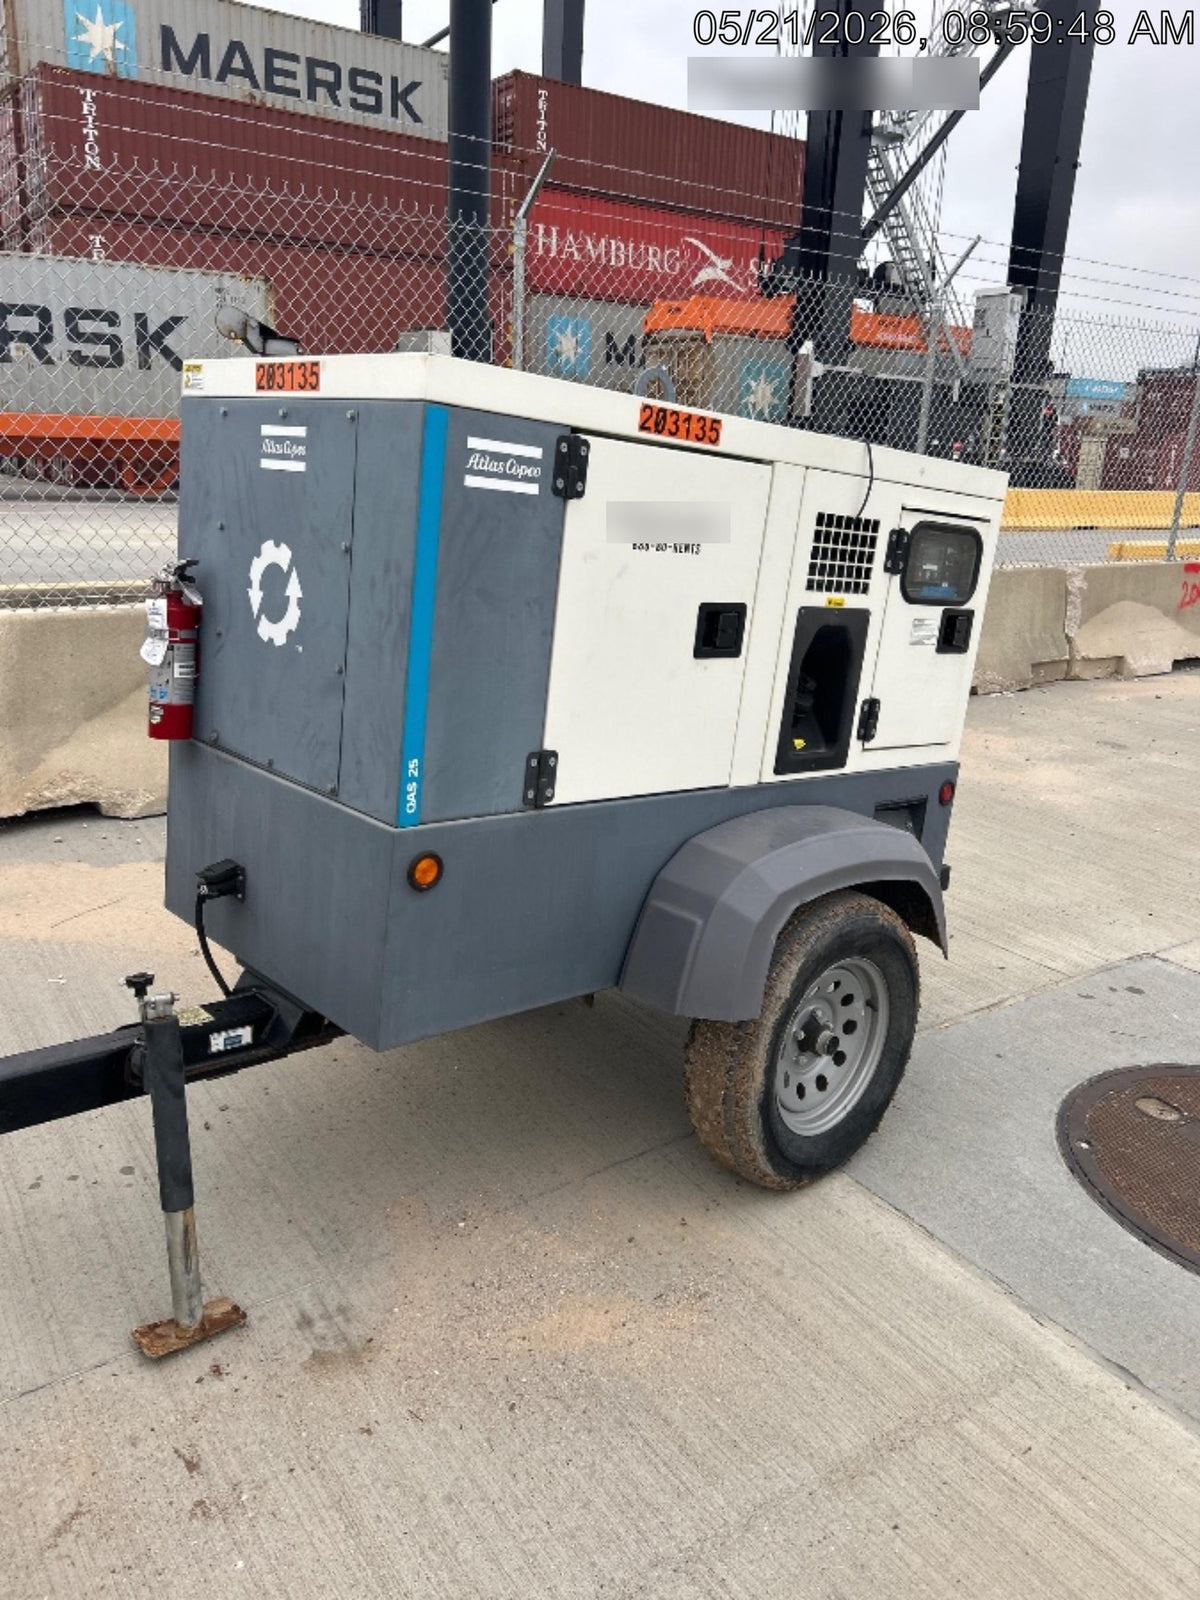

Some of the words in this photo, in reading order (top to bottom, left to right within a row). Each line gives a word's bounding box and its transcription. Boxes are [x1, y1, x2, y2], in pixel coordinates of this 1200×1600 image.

[160, 24, 424, 124] MAERSK
[79, 88, 101, 170] TRITON
[536, 89, 549, 152] TRITON
[534, 223, 681, 276] HAMBURG
[256, 362, 320, 391] 203135
[640, 404, 721, 444] 203135
[465, 453, 504, 473] Atlas
[505, 458, 541, 478] Copco
[408, 758, 419, 778] 25
[406, 781, 418, 814] QAS
